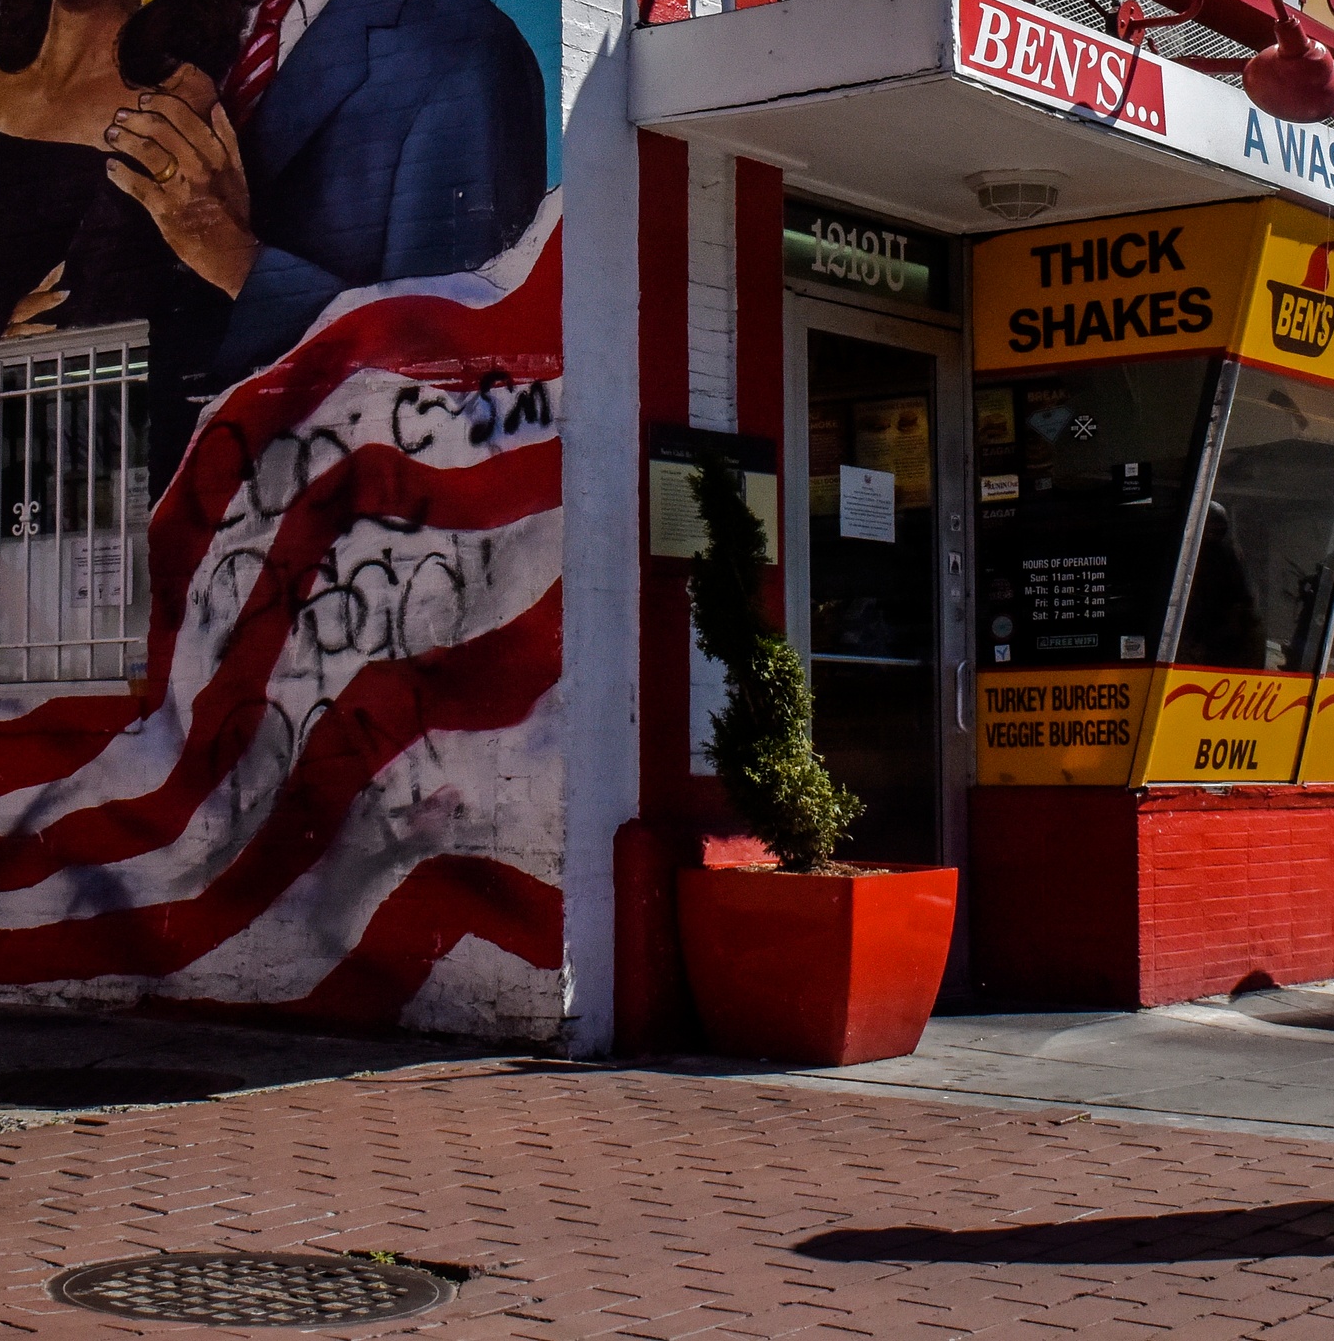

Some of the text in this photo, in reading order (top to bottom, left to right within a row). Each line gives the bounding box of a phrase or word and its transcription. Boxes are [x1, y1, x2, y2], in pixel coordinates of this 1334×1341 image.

[1244, 108, 1269, 164] A
[811, 218, 908, 292] 1213U
[1030, 226, 1186, 288] THICK
[1008, 286, 1214, 353] SHAKES
[1275, 292, 1334, 347] BEN'S
[1022, 556, 1107, 569] HOURS OF OPERATION
[1030, 573, 1048, 582] Sun:
[1052, 572, 1075, 582] 11am
[1082, 571, 1105, 582] 11pm
[1024, 585, 1049, 595] M-Th:
[1061, 586, 1075, 594] am
[1091, 585, 1105, 593] am
[1035, 598, 1048, 608] Fri:
[1061, 599, 1075, 607] am
[1032, 611, 1048, 620] Sat:
[1050, 637, 1073, 646] FREE
[984, 683, 1130, 713] TURKEY BURGERS
[1199, 678, 1283, 722] Chili
[986, 718, 1130, 748] VEGGIE BURGERS
[1194, 738, 1259, 770] BOWL
